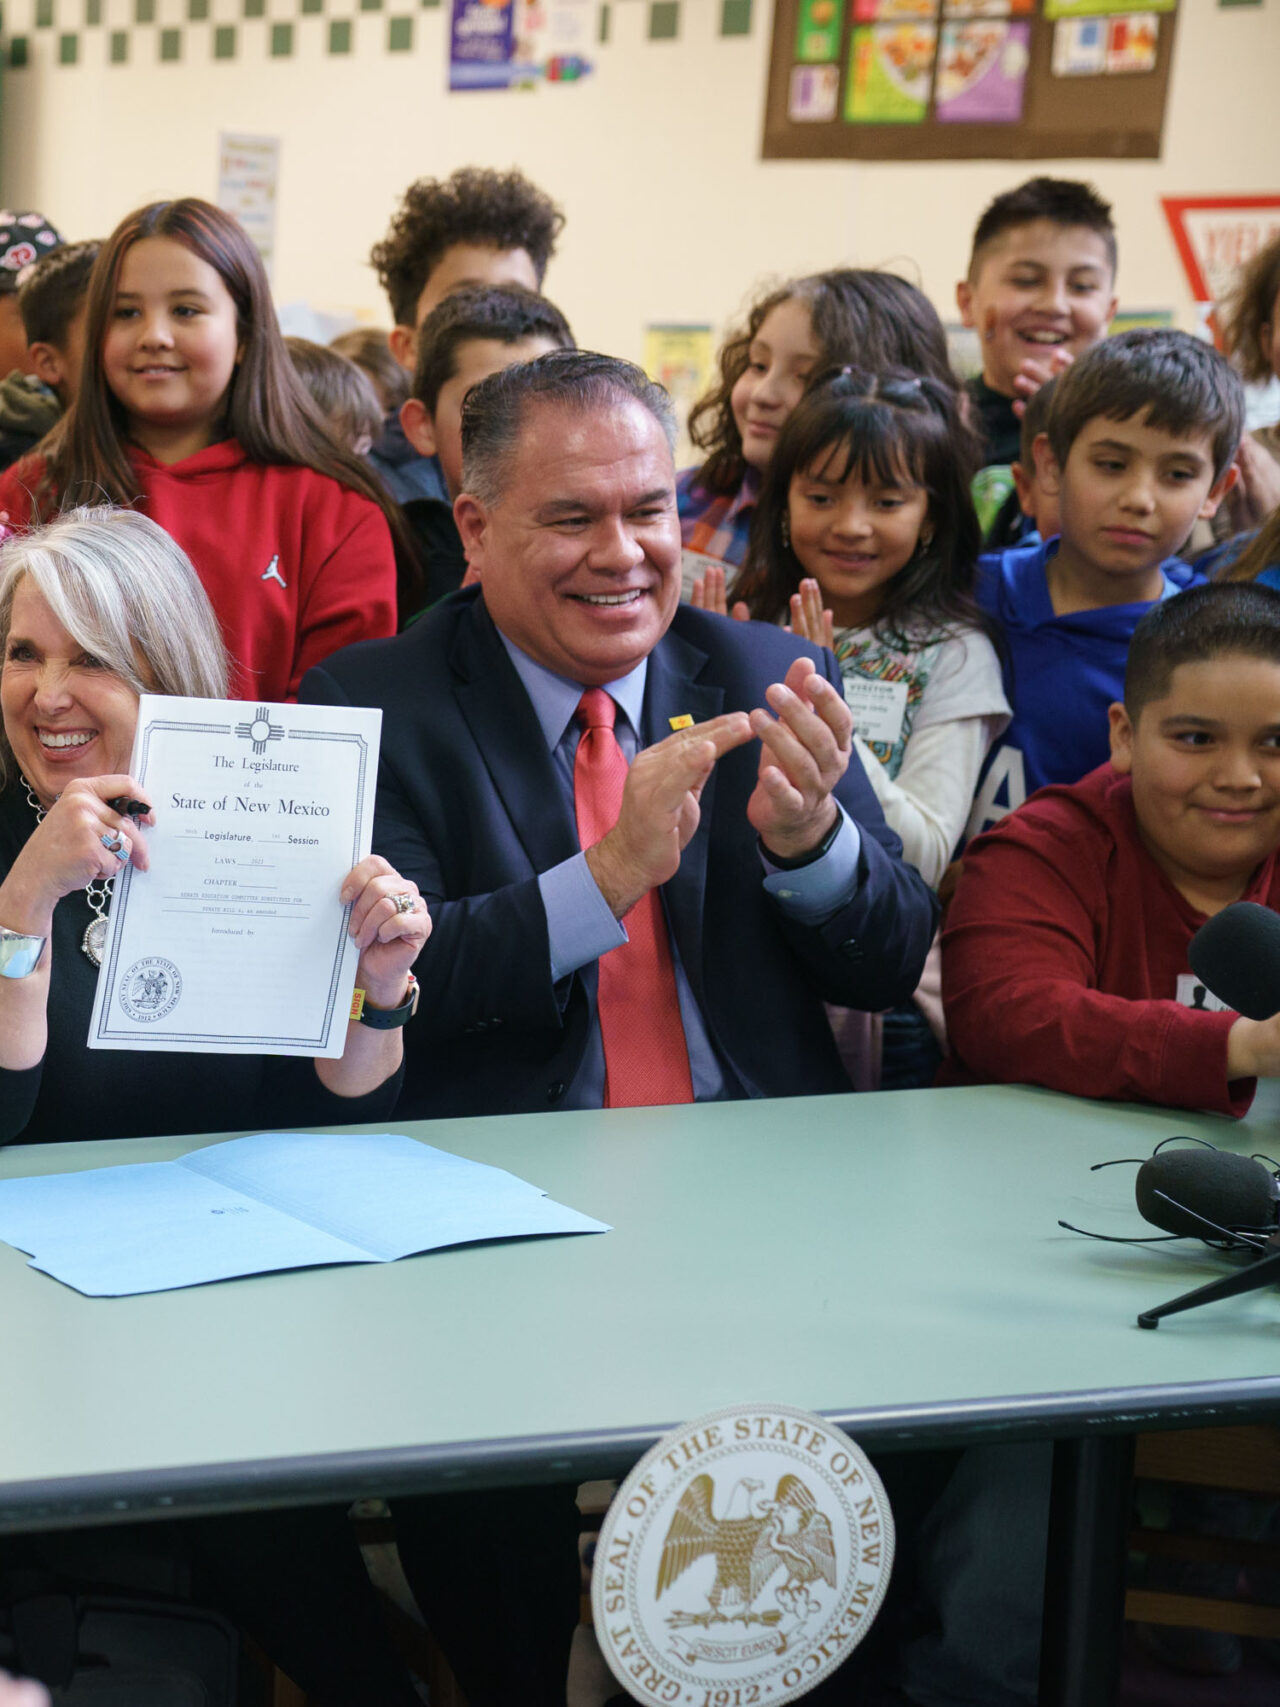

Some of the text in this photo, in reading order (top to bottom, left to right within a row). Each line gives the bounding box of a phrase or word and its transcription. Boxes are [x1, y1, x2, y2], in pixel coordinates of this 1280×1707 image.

[213, 755, 300, 774] The Legislature
[171, 793, 330, 816] State of New Mexico
[287, 835, 320, 846] Session
[214, 857, 236, 865] LAWS
[203, 878, 238, 887] CHAPTER
[605, 1416, 881, 1701] GREAT SEAL OF THE STATE OF NEW MEXICO
[703, 1684, 761, 1707] 1912
